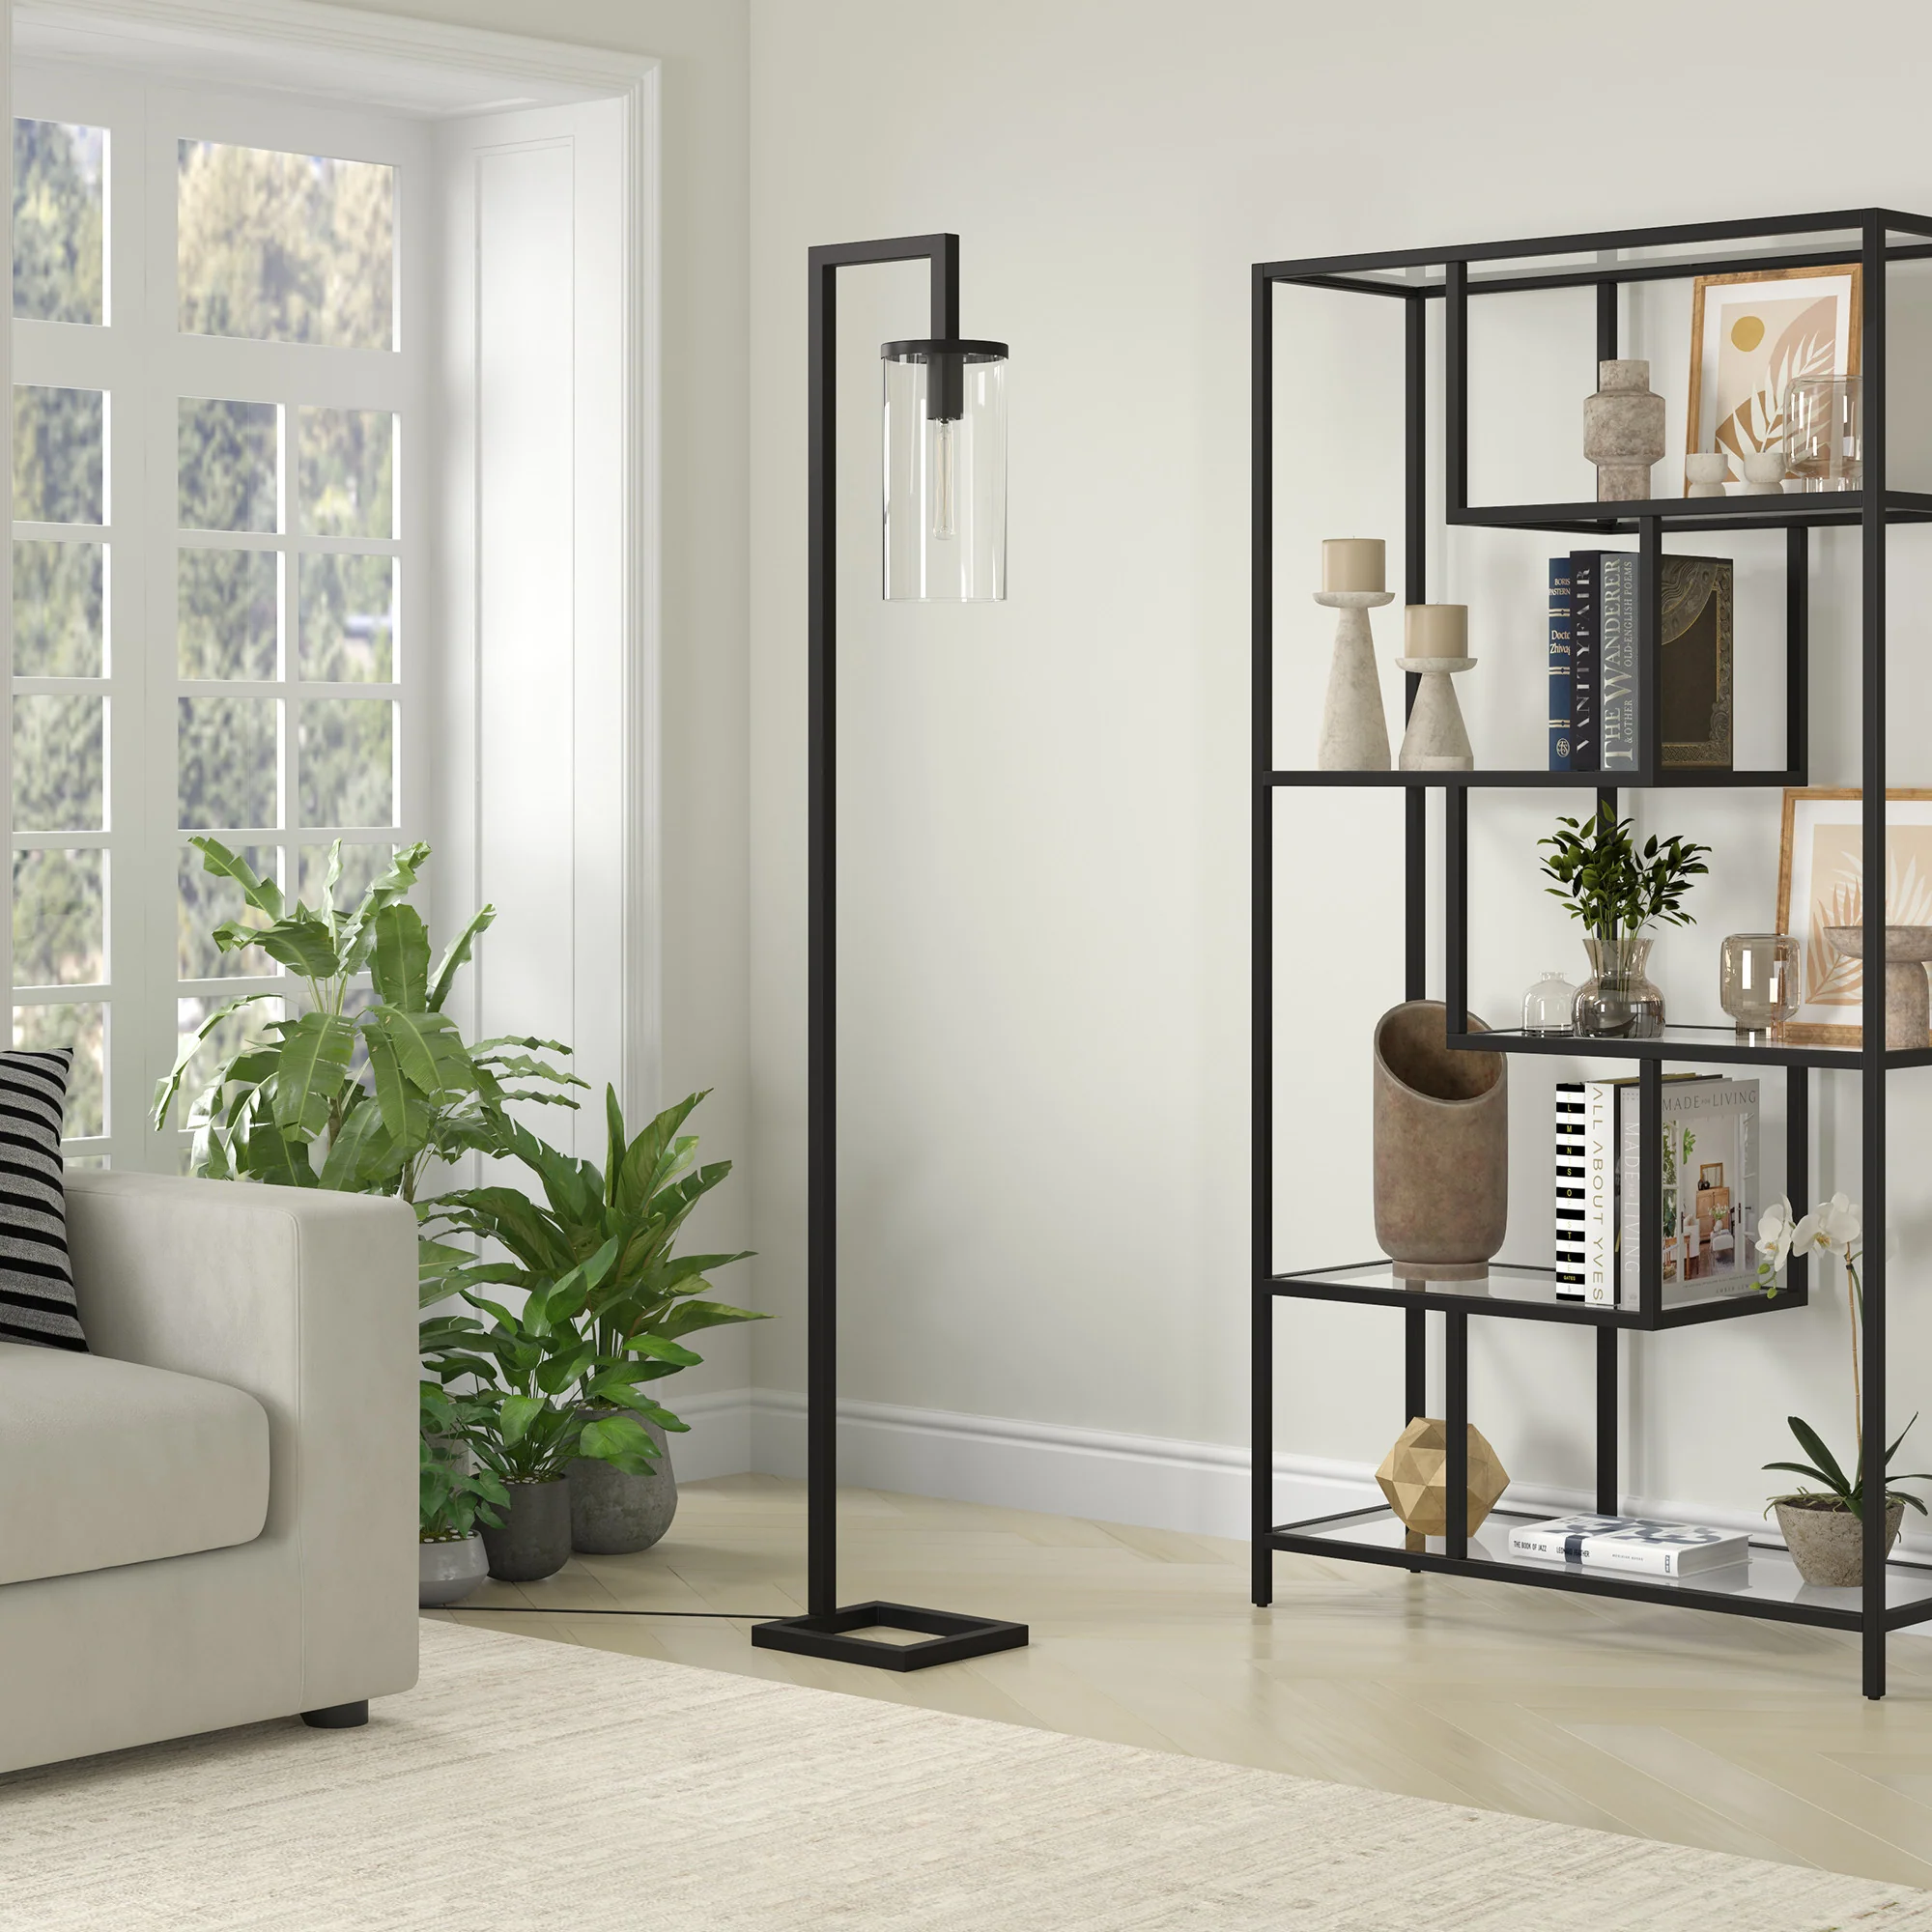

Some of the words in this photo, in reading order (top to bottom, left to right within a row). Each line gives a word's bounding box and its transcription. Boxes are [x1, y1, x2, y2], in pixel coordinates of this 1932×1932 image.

[1553, 578, 1571, 586] BORIS
[1623, 561, 1633, 596] POEMS
[1604, 558, 1633, 705] WANDERER
[1623, 598, 1633, 668] OLD-ENGLISH
[1604, 708, 1633, 768] THE
[1623, 699, 1633, 736] OTHER
[1592, 1087, 1604, 1130] ALL
[1662, 1094, 1700, 1112] MADE
[1713, 1090, 1757, 1107] LIVING
[1624, 1122, 1640, 1180] MADE
[1592, 1140, 1604, 1225] ABOUT
[1624, 1202, 1640, 1274] LIVING
[1592, 1236, 1604, 1301] YVES
